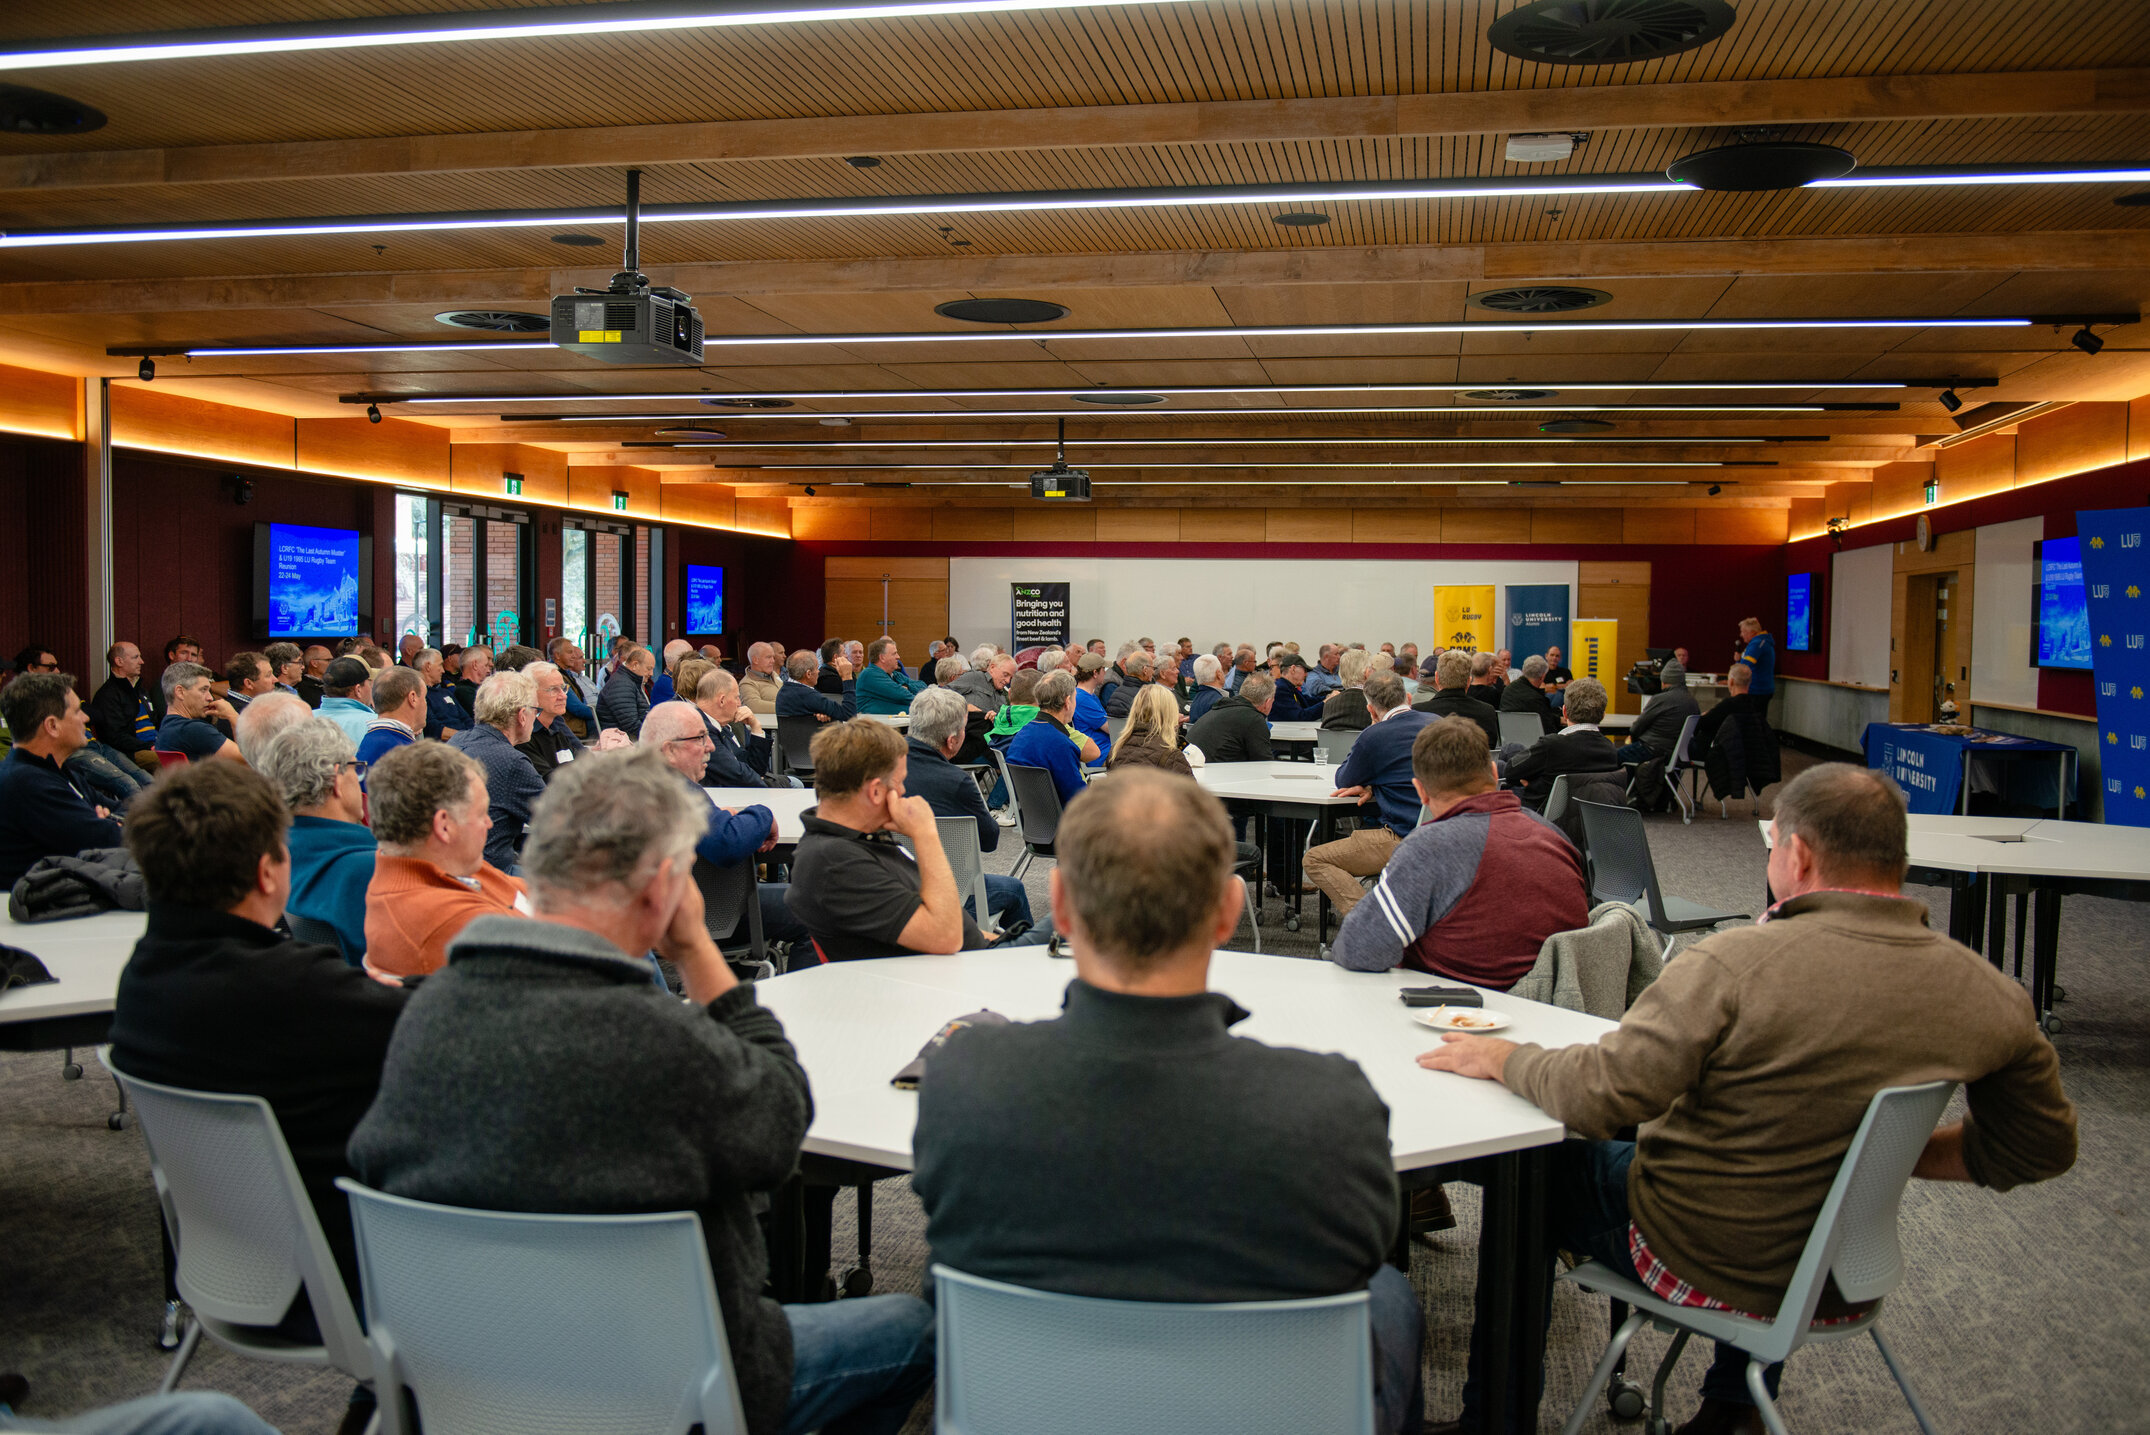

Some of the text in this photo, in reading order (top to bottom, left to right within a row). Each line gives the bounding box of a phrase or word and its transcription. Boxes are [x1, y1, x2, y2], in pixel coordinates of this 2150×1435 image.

[1016, 587, 1040, 596] ANZCO
[1016, 599, 1063, 609] Bringing you
[1016, 609, 1065, 617] nutrition and
[1016, 619, 1062, 629] good health
[1896, 746, 1925, 768] LINCOLN
